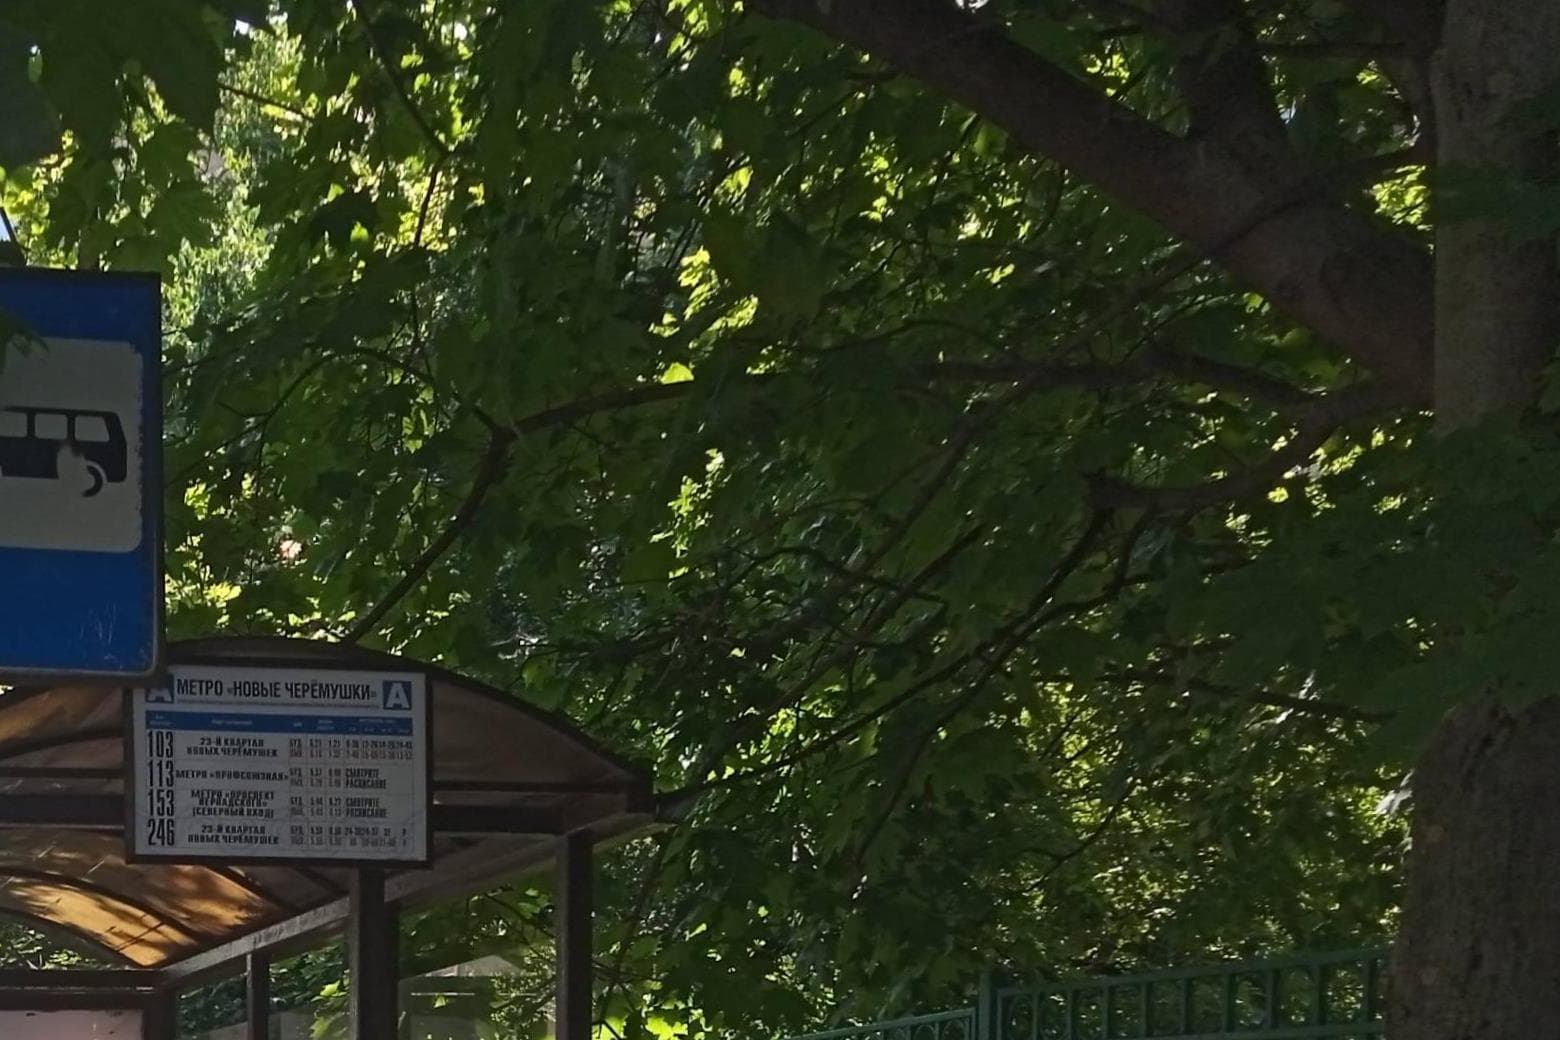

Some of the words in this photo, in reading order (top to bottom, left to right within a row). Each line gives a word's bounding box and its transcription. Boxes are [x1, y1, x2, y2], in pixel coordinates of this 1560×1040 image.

[177, 678, 223, 697] МЕТРО
[227, 680, 281, 699] «НОВЫЕ
[285, 679, 376, 701] ЧЕРЁМУШКИ»
[148, 731, 174, 758] 103
[148, 760, 174, 787] 113
[148, 789, 175, 816] 153
[147, 819, 175, 847] 246
